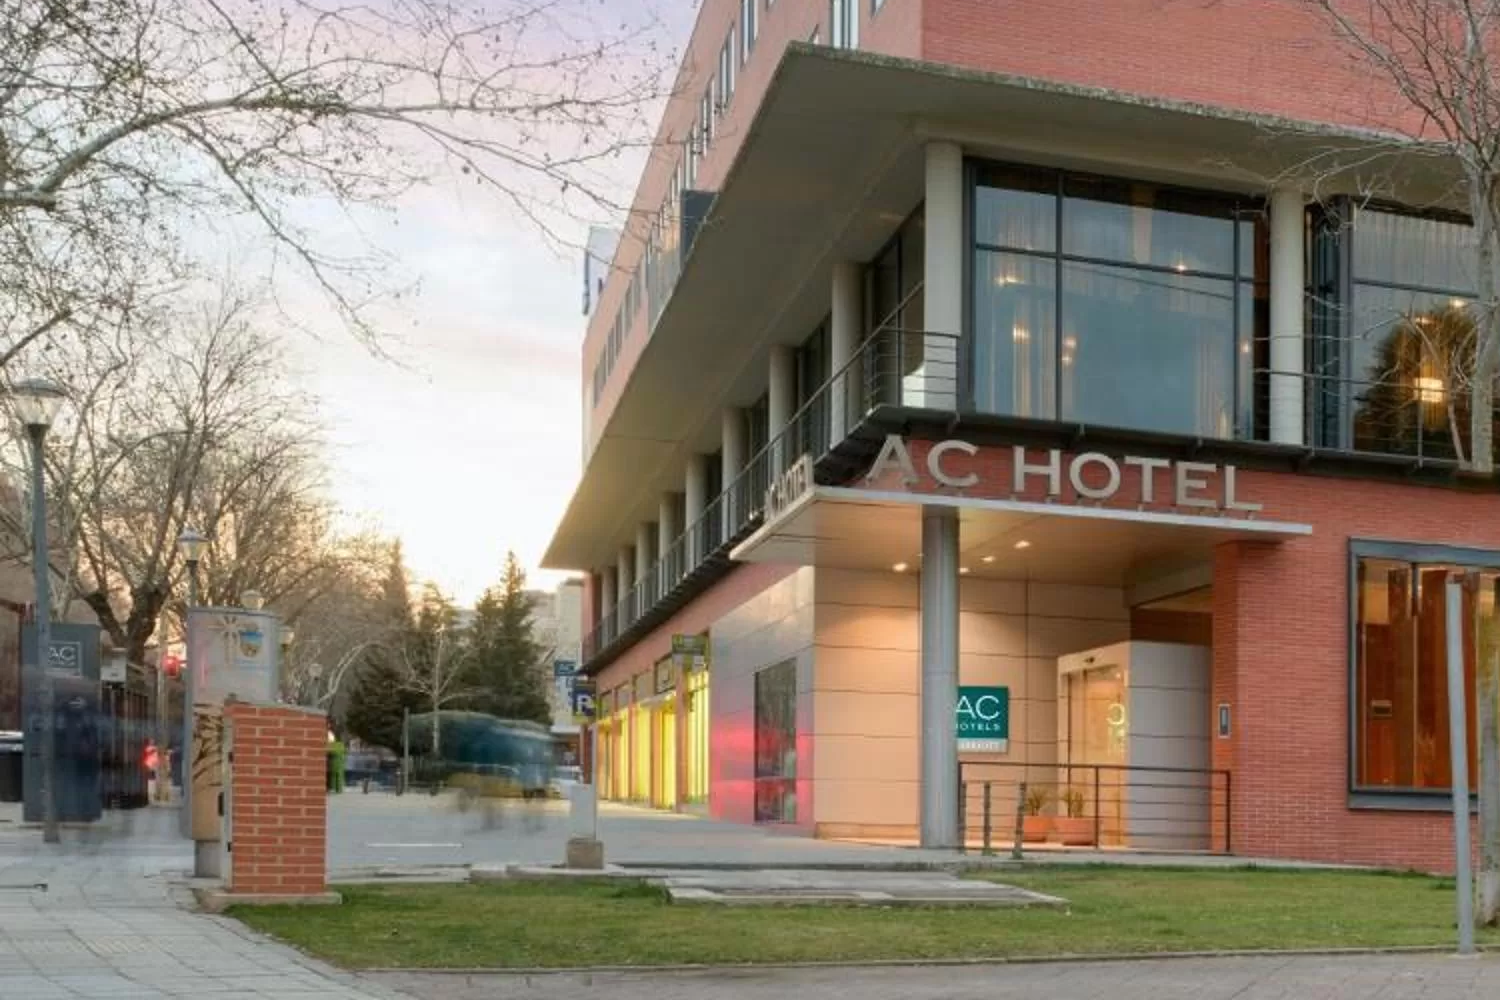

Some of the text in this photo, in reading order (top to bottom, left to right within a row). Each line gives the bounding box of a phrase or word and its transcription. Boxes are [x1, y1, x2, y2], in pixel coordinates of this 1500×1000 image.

[866, 434, 1263, 510] AC HOTEL
[956, 695, 999, 720] AC
